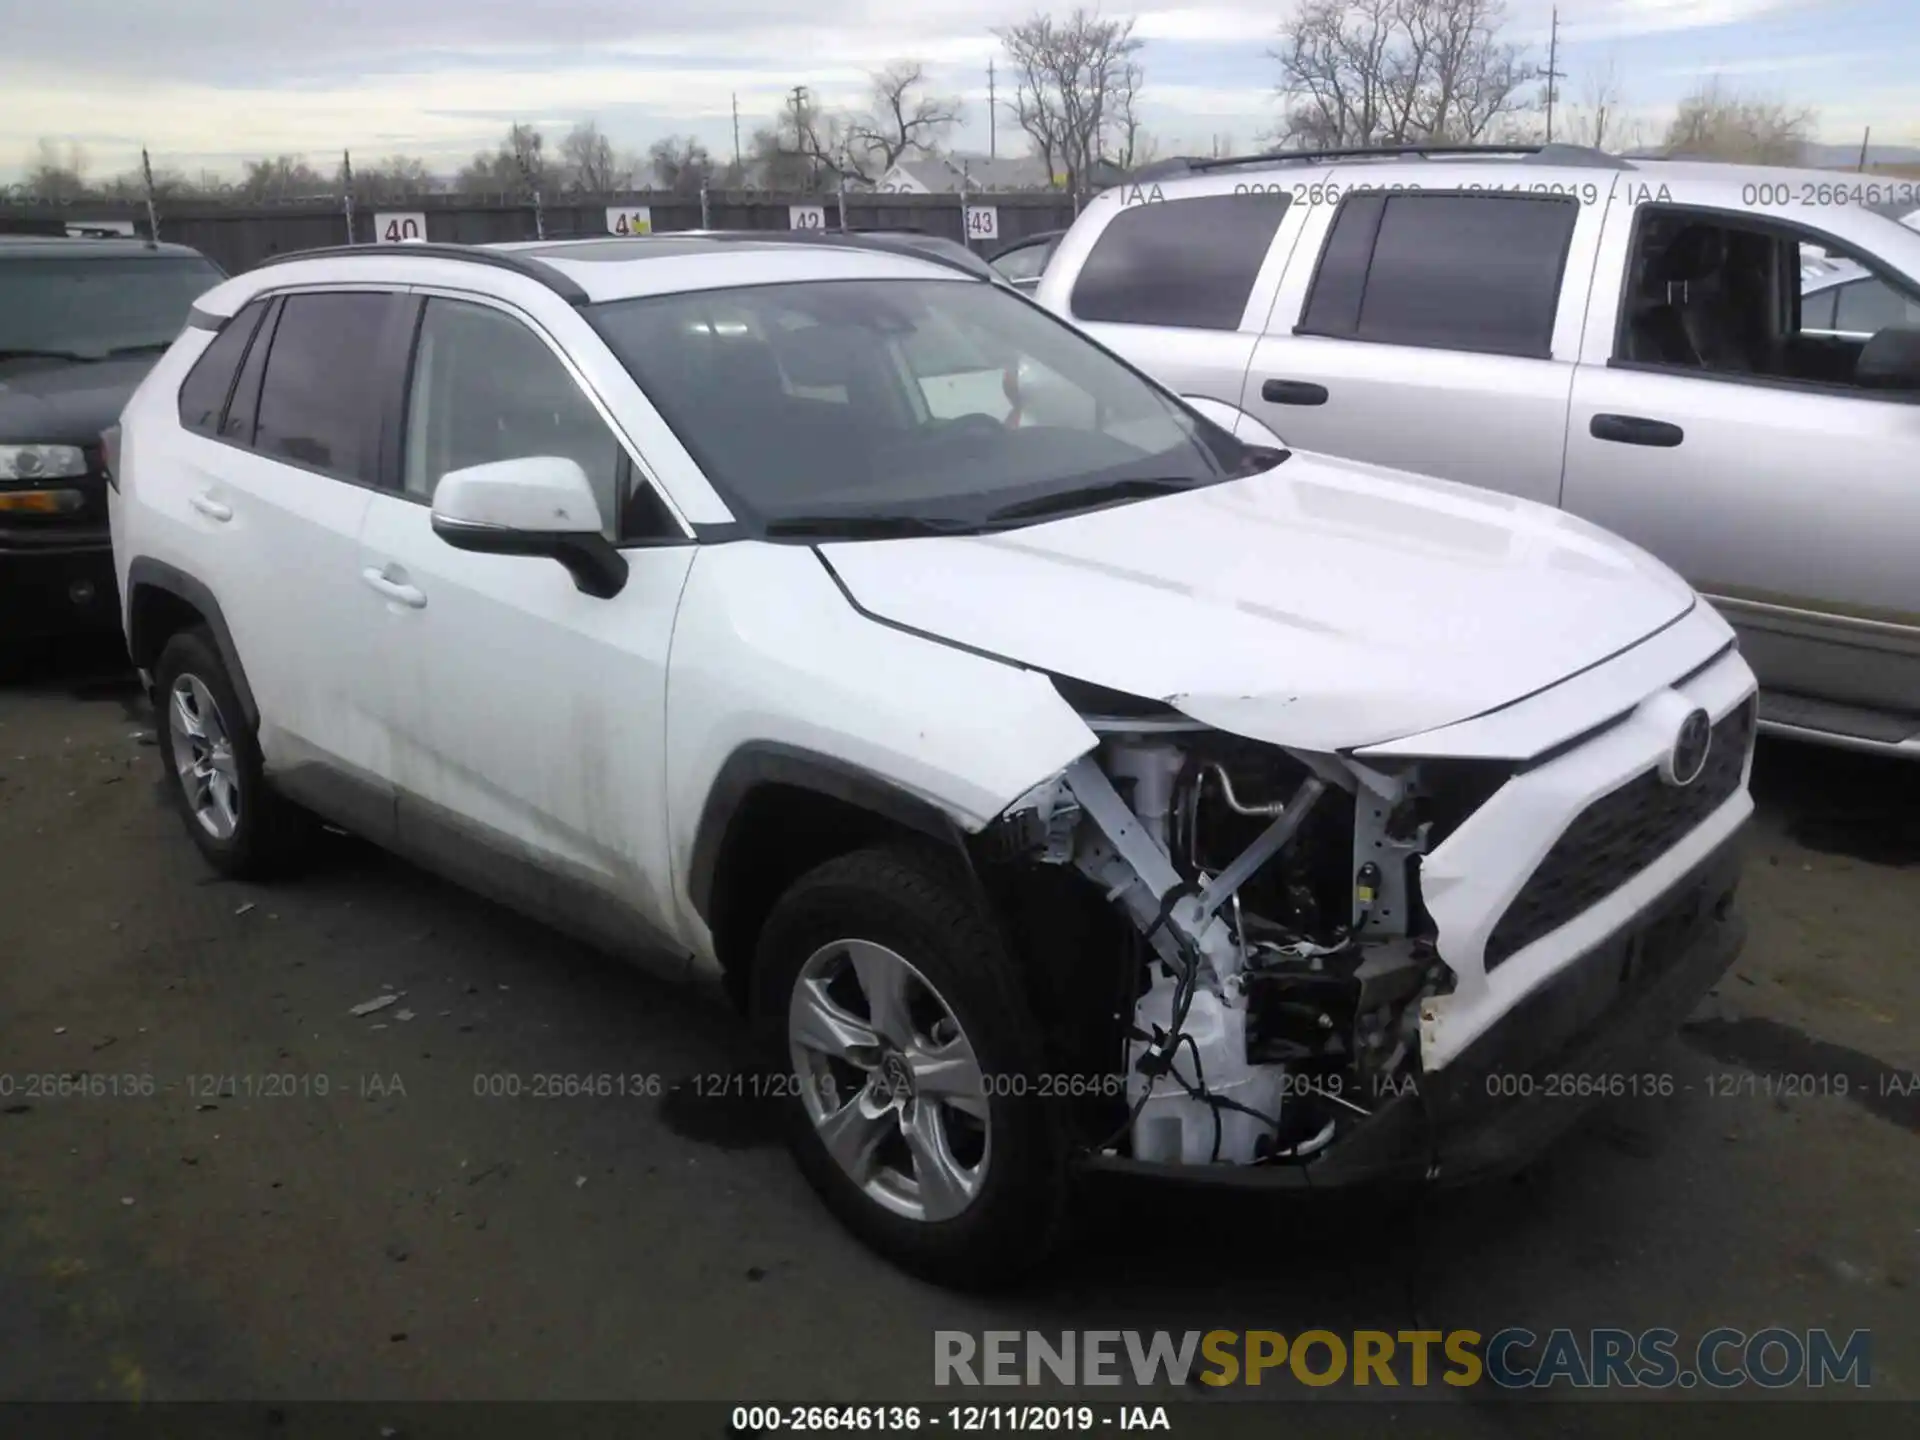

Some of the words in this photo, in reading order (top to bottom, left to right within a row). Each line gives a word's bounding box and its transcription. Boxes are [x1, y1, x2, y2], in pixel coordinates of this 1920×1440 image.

[384, 217, 418, 242] 40
[797, 211, 819, 230] 42
[973, 211, 993, 234] 43
